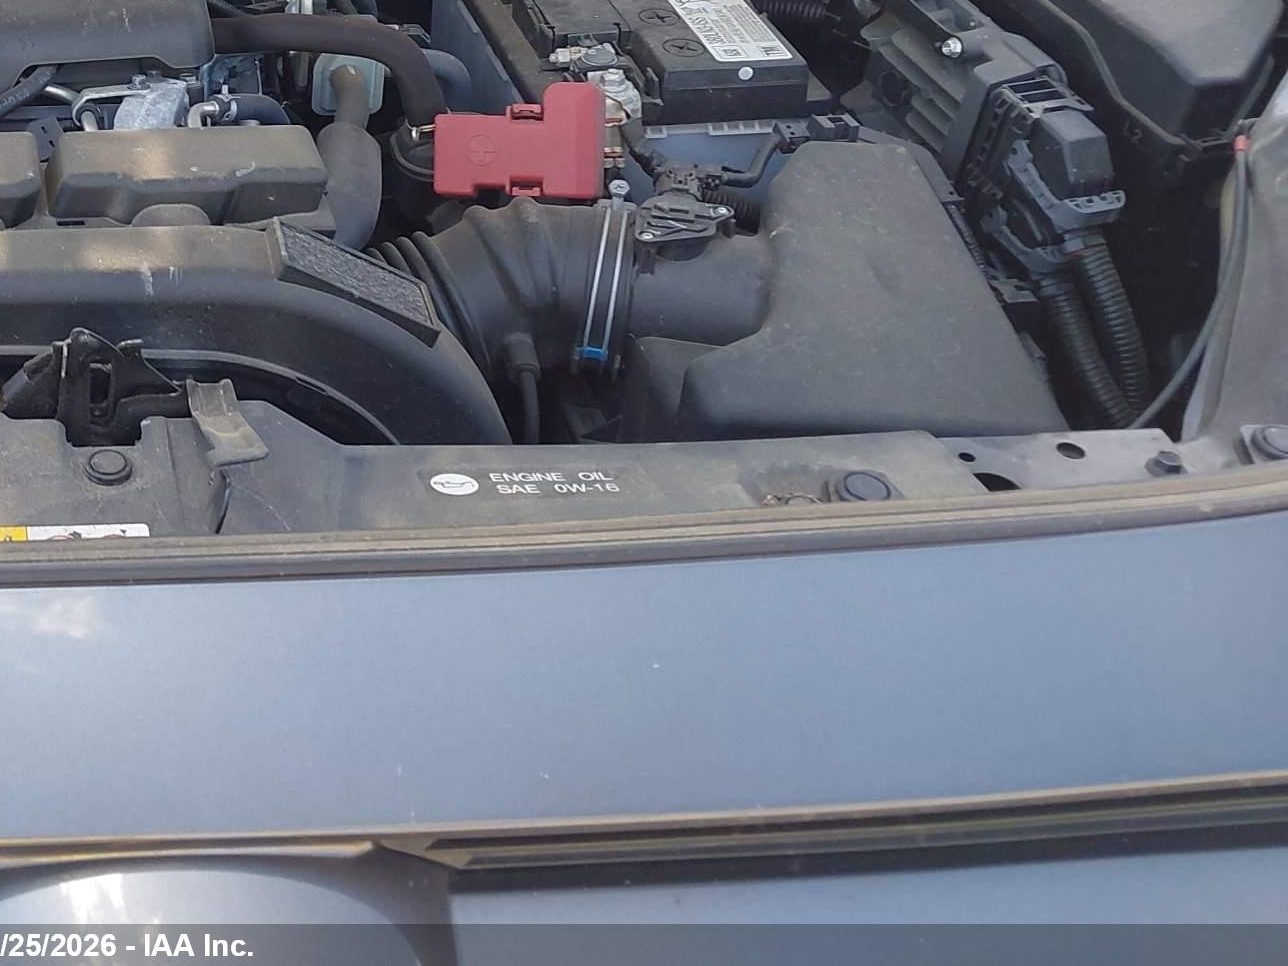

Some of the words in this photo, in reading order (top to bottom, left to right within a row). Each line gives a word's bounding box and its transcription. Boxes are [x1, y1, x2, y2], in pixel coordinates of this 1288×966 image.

[489, 472, 567, 483] ENGINE
[577, 471, 613, 482] OIL
[496, 483, 541, 494] SAE
[553, 483, 621, 494] 0W-16
